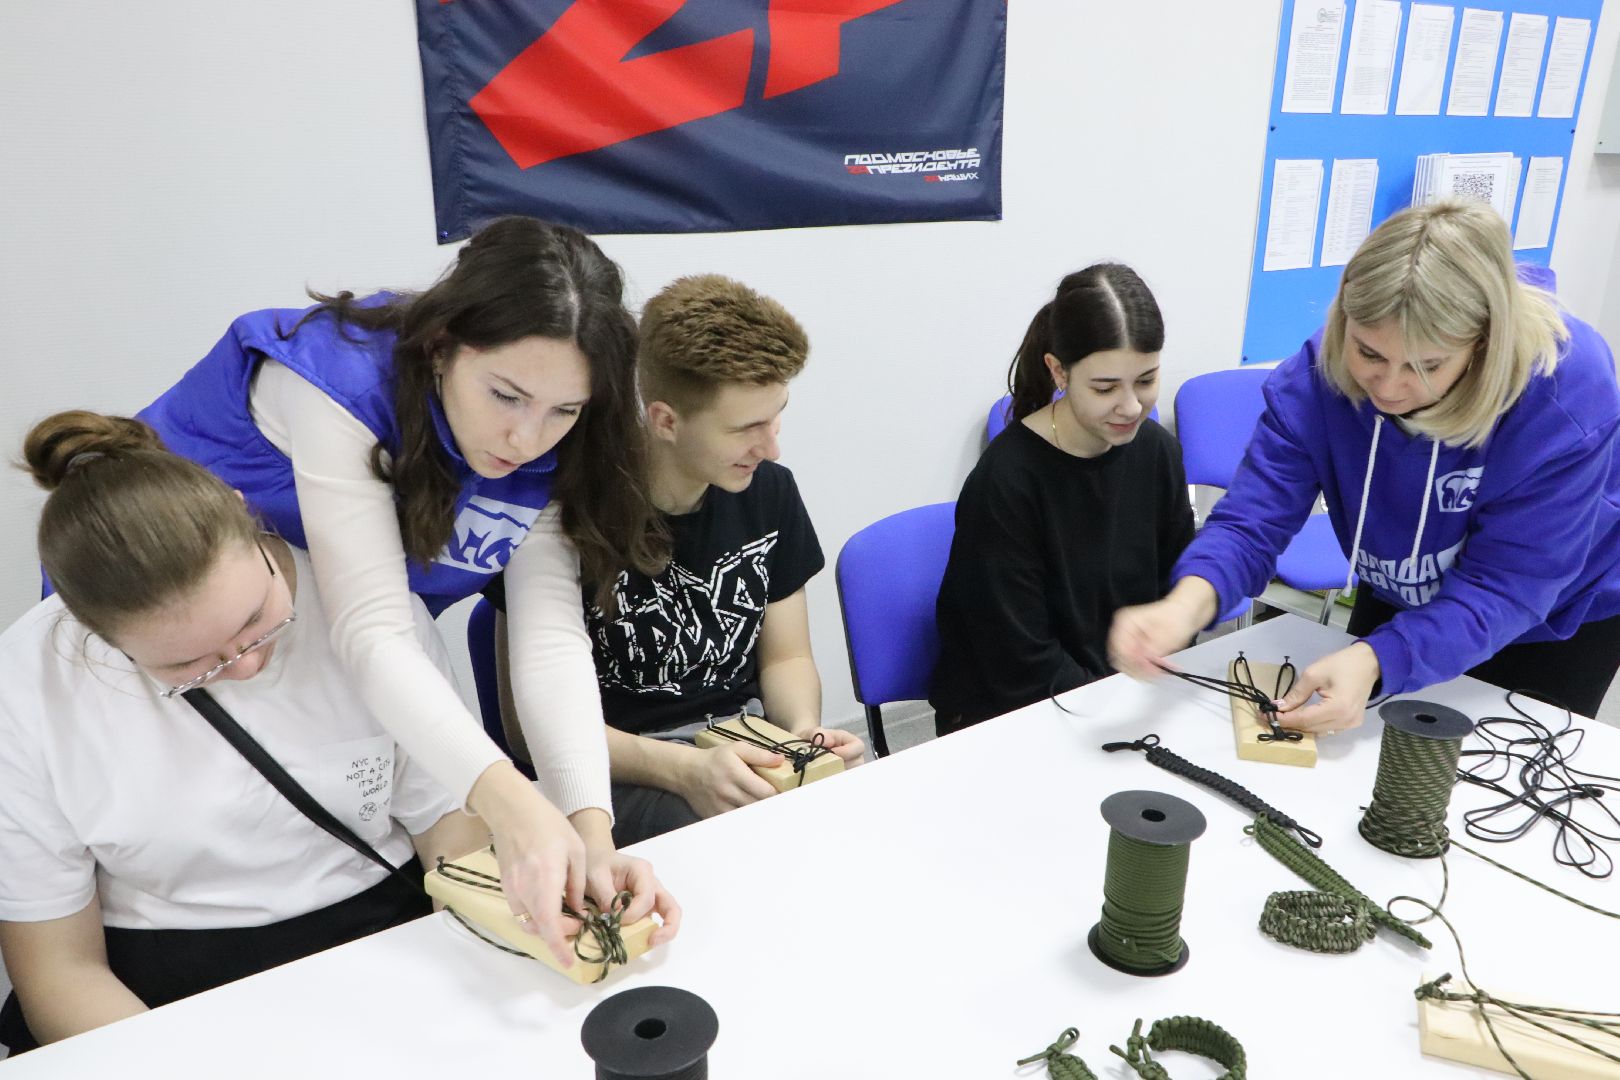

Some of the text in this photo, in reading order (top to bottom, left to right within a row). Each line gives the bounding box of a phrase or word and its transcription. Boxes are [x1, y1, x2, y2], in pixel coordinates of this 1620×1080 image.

[845, 148, 980, 165] ПОДМОСКОВЬЕ
[352, 758, 369, 769] NYC
[346, 769, 366, 781] NOT
[358, 773, 383, 788] IT'S A
[362, 780, 388, 797] WORLD
